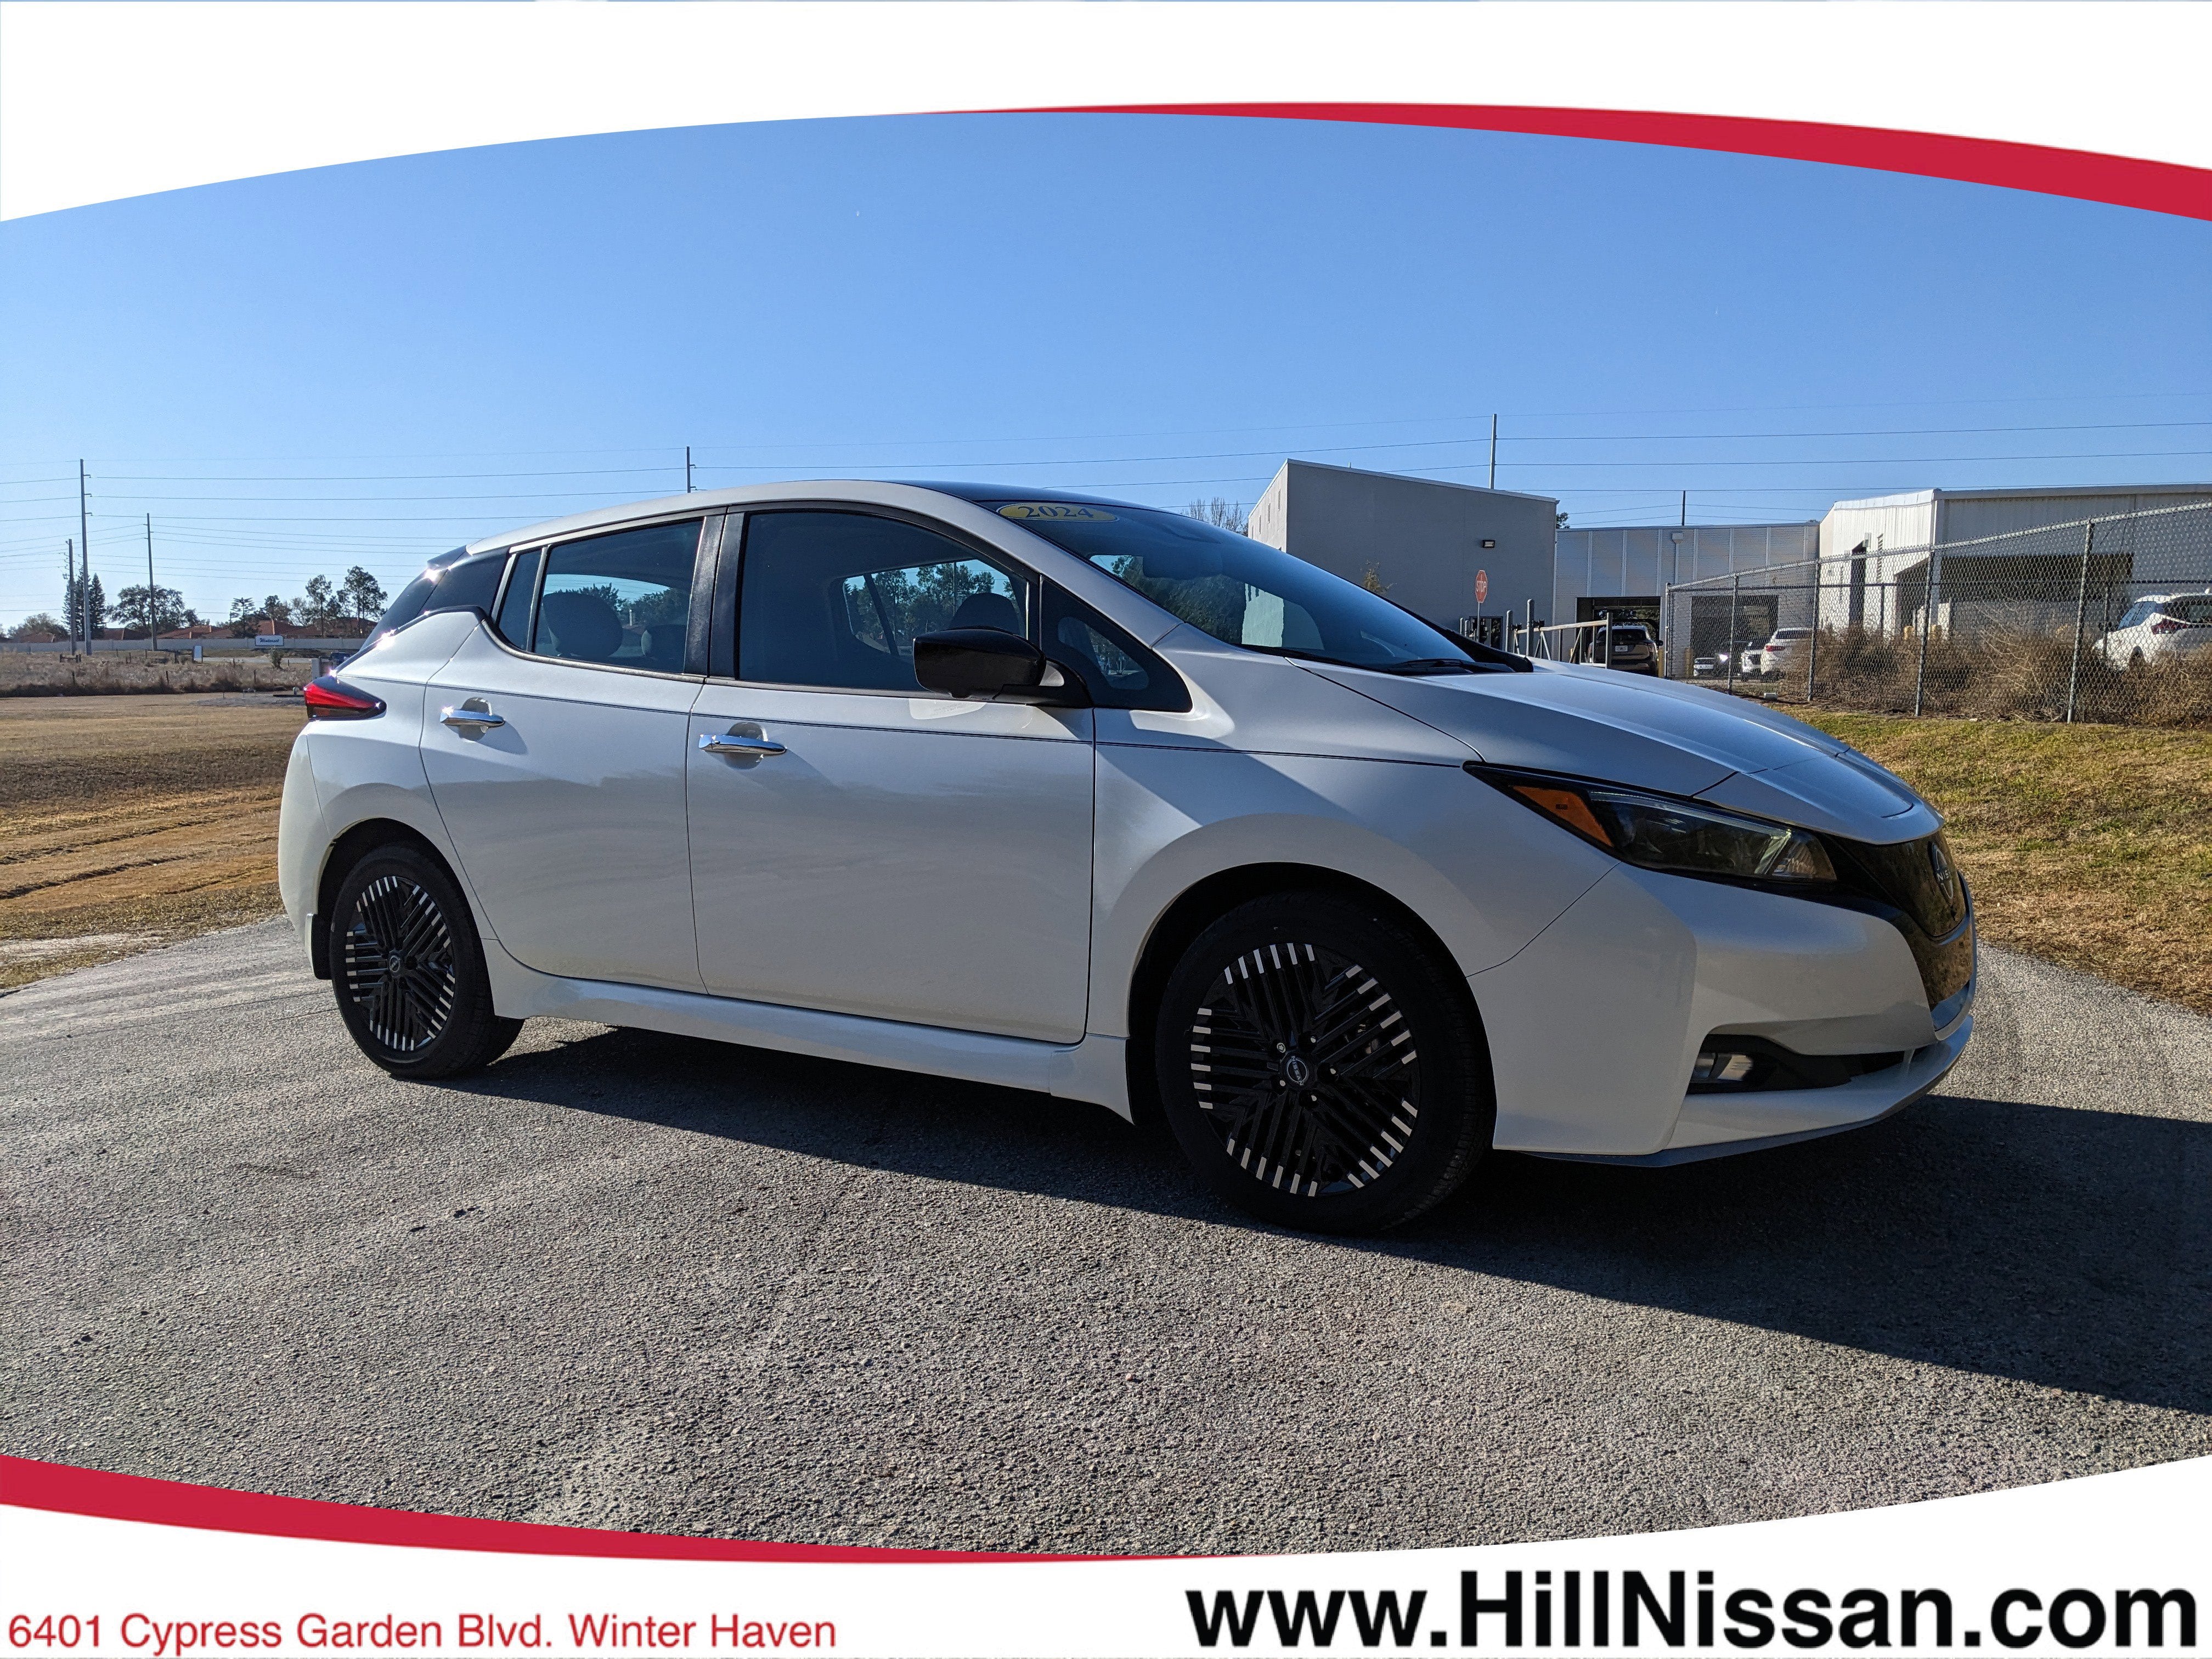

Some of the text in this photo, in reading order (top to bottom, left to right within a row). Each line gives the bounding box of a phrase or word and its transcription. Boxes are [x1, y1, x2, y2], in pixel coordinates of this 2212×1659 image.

[1018, 506, 1093, 518] 2024
[1476, 580, 1487, 592] STOP
[1291, 1056, 1304, 1086] NISSAN
